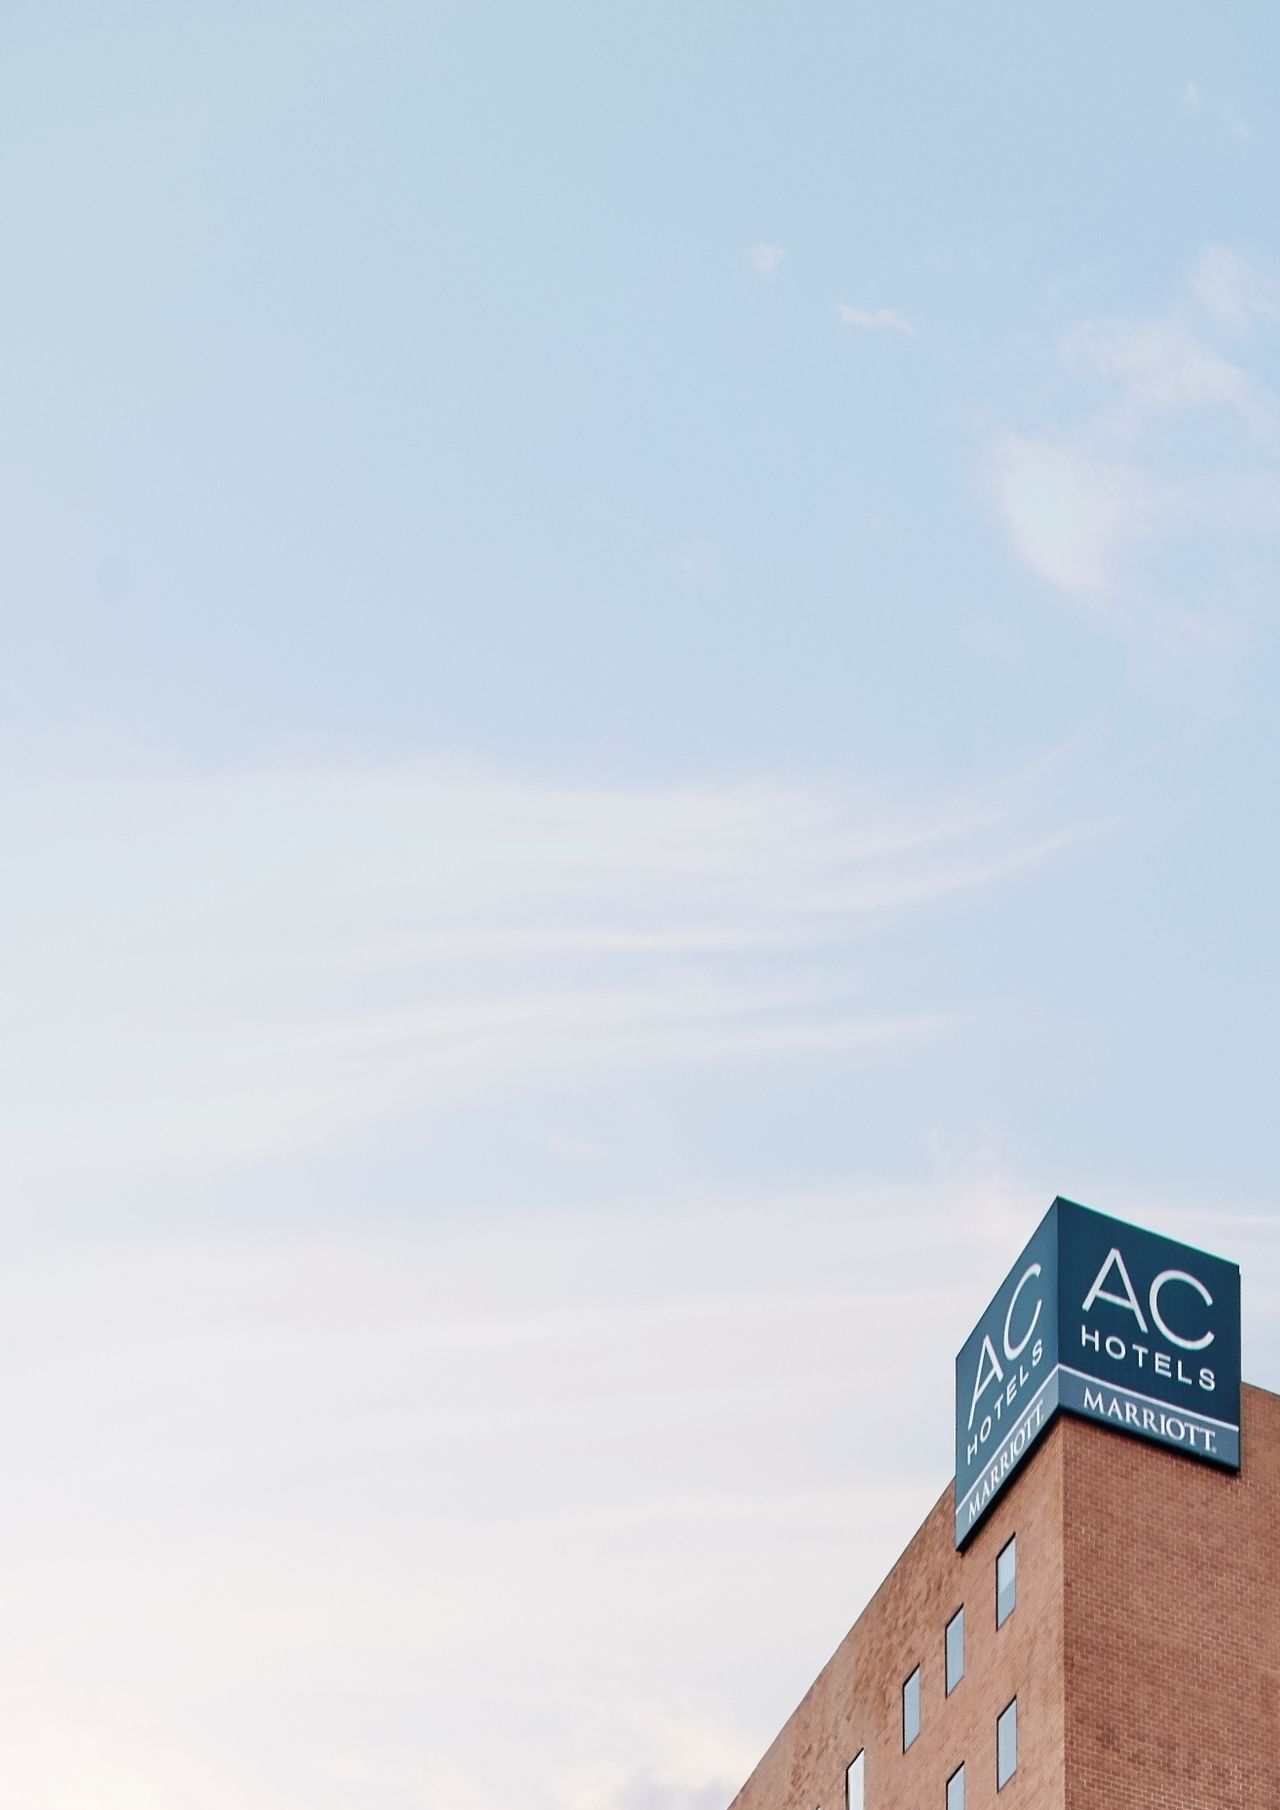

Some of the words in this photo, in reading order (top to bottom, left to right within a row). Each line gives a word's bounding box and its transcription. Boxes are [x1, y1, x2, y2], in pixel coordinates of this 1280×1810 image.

[967, 1262, 1042, 1431] AC
[1081, 1247, 1215, 1351] AC
[967, 1338, 1043, 1467] HOTELS
[1081, 1325, 1216, 1392] HOTELS
[967, 1399, 1044, 1524] MARRIOTT
[1083, 1387, 1216, 1453] MARRIOTT
